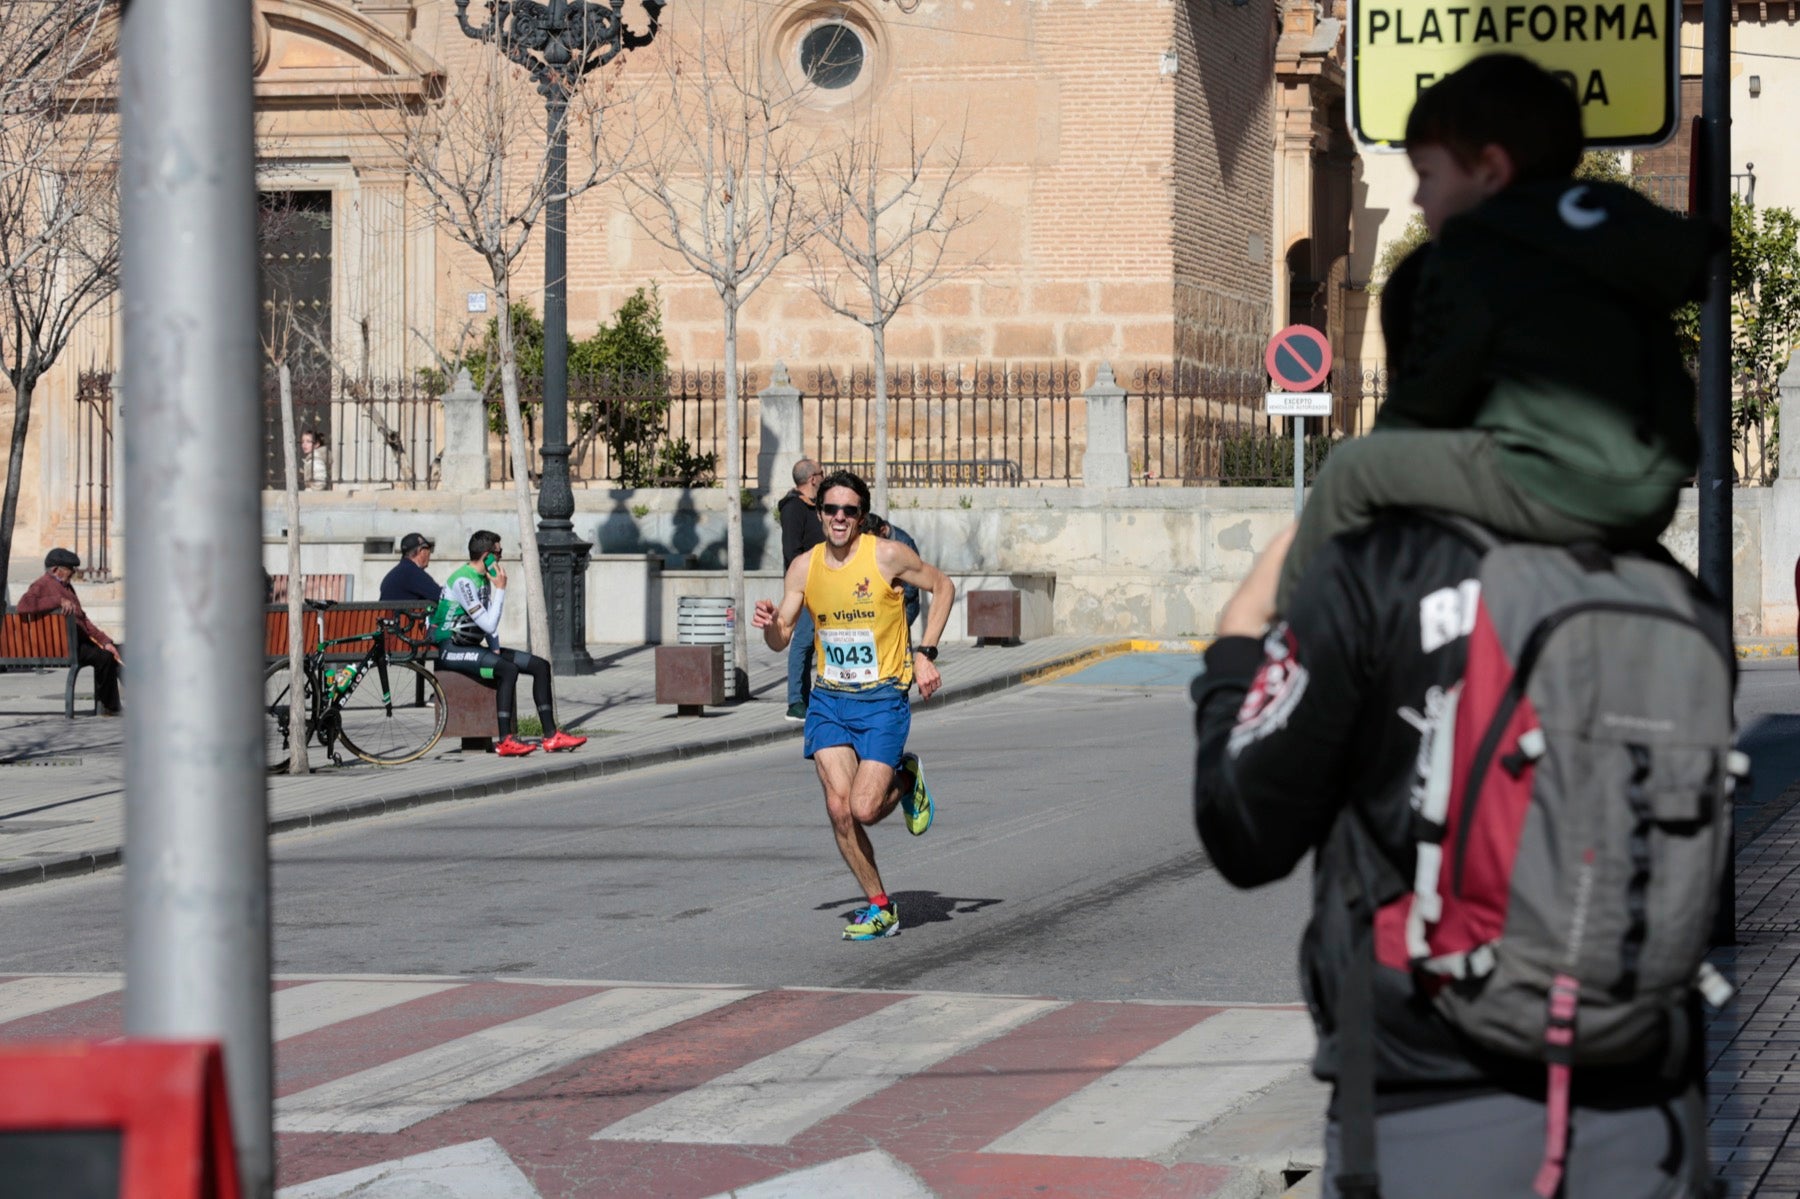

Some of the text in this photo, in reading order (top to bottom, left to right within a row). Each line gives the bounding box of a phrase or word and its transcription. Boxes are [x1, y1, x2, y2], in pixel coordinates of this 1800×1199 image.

[1368, 3, 1658, 45] PLATAFORMA
[1283, 397, 1312, 405] EXCEPTO
[833, 609, 875, 622] Vigilsa
[826, 645, 874, 665] 1043
